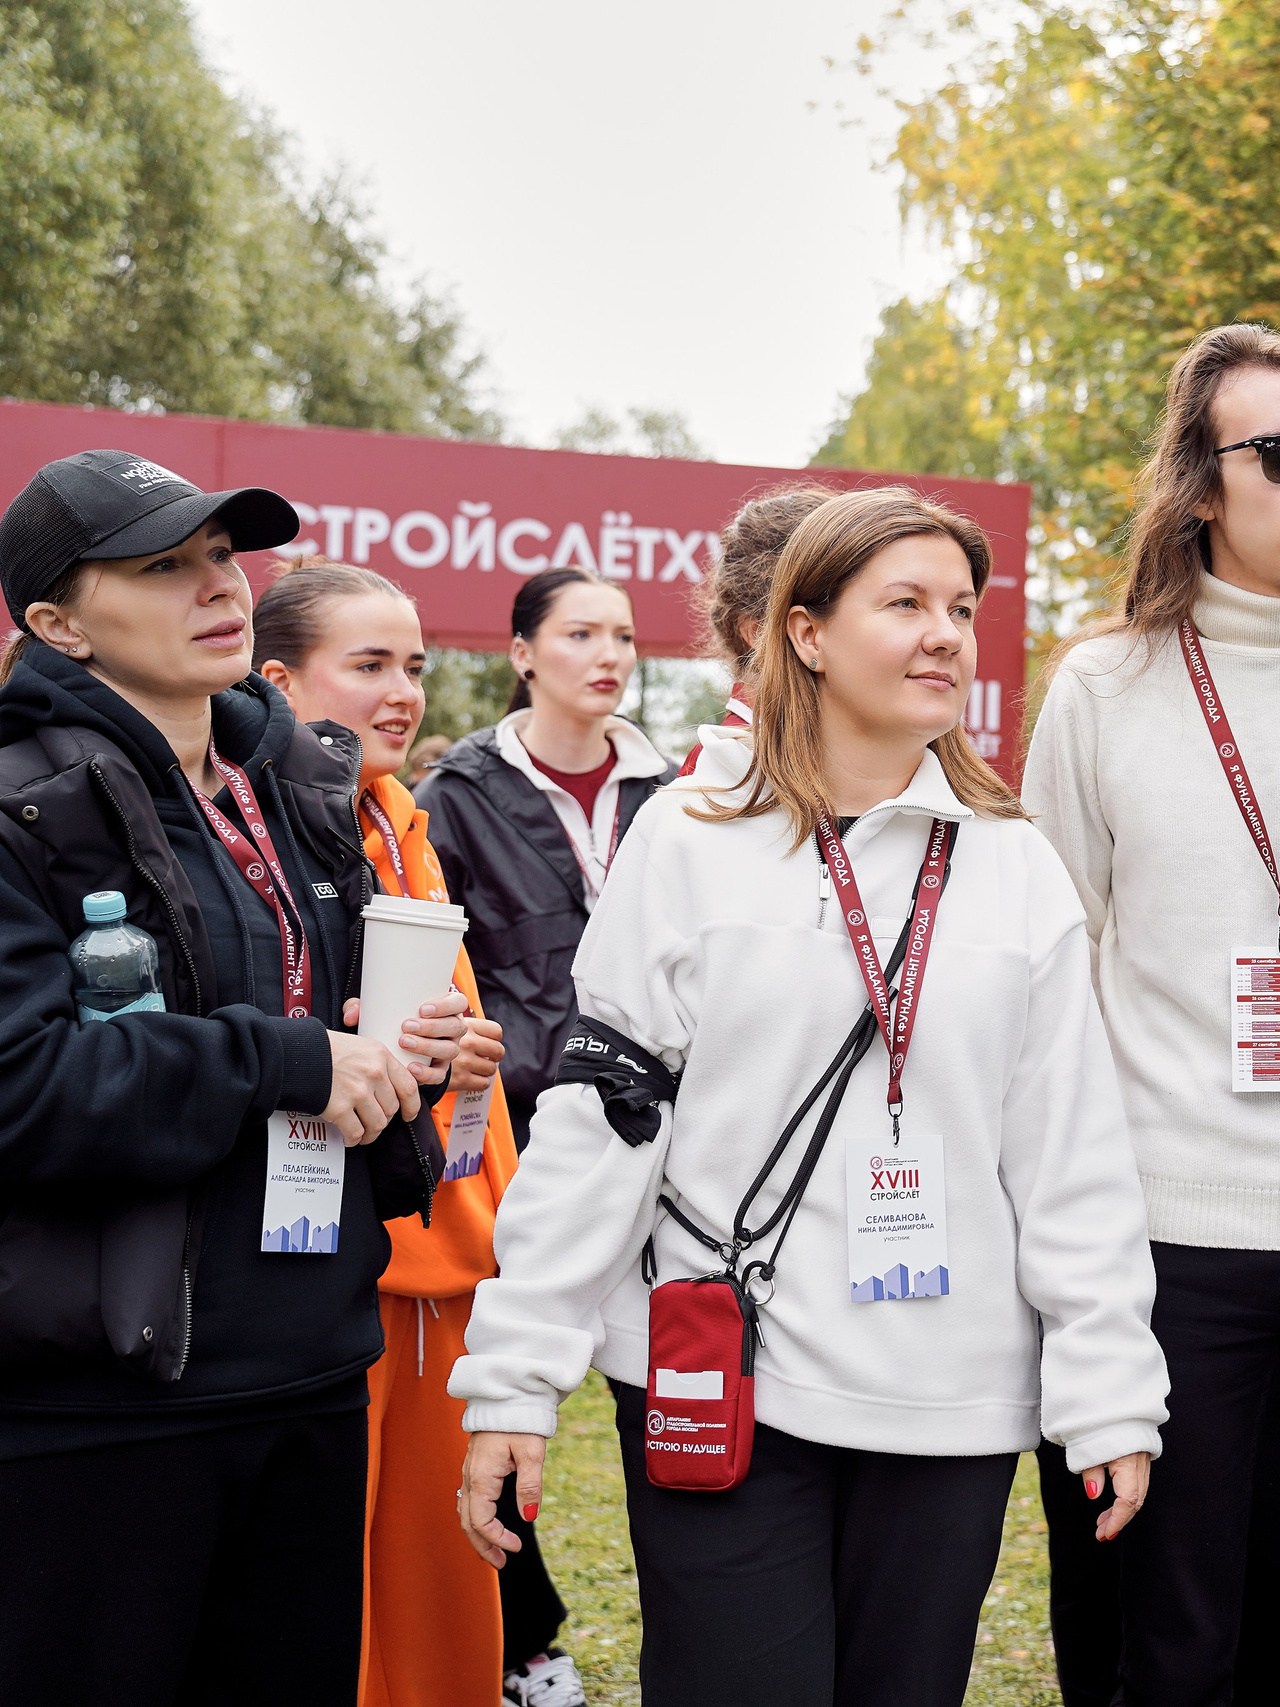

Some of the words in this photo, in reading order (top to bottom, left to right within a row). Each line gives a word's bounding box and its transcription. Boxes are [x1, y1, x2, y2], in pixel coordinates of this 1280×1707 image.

[1199, 678, 1221, 723] ГОРОДА
[1230, 764, 1240, 773] Я
[1234, 774, 1265, 840] ФУНДАМЕНТ
[201, 801, 238, 844] ГОРОДА
[386, 834, 404, 876] ГОРОДА
[826, 839, 851, 887] ГОРОДА
[317, 885, 333, 895] CG
[856, 933, 868, 943] Я
[912, 908, 931, 956] ГОРОДА
[861, 944, 890, 1018] ФУНДАМЕНТ
[897, 957, 921, 1031] ФУНДАМЕНТ
[896, 1035, 906, 1043] Я
[288, 1119, 327, 1141] XVIII
[287, 1141, 328, 1152] СТРОЙСЛЁТ
[282, 1163, 331, 1175] ПЕЛАГЕЙКИНА
[271, 1174, 306, 1184] АЛЕКСАНДРА
[307, 1176, 341, 1185] ВИКТОРОВНА
[870, 1169, 919, 1190] XVIII
[869, 1189, 921, 1202] СТРОЙСЛЁТ
[865, 1212, 927, 1224] СЕЛИВАНОВА
[857, 1225, 877, 1234] НИНА
[878, 1223, 935, 1233] ВЛАДИМИРОВНА
[883, 1235, 911, 1243] участник
[682, 1443, 727, 1455] БУДУЩЕЕ
